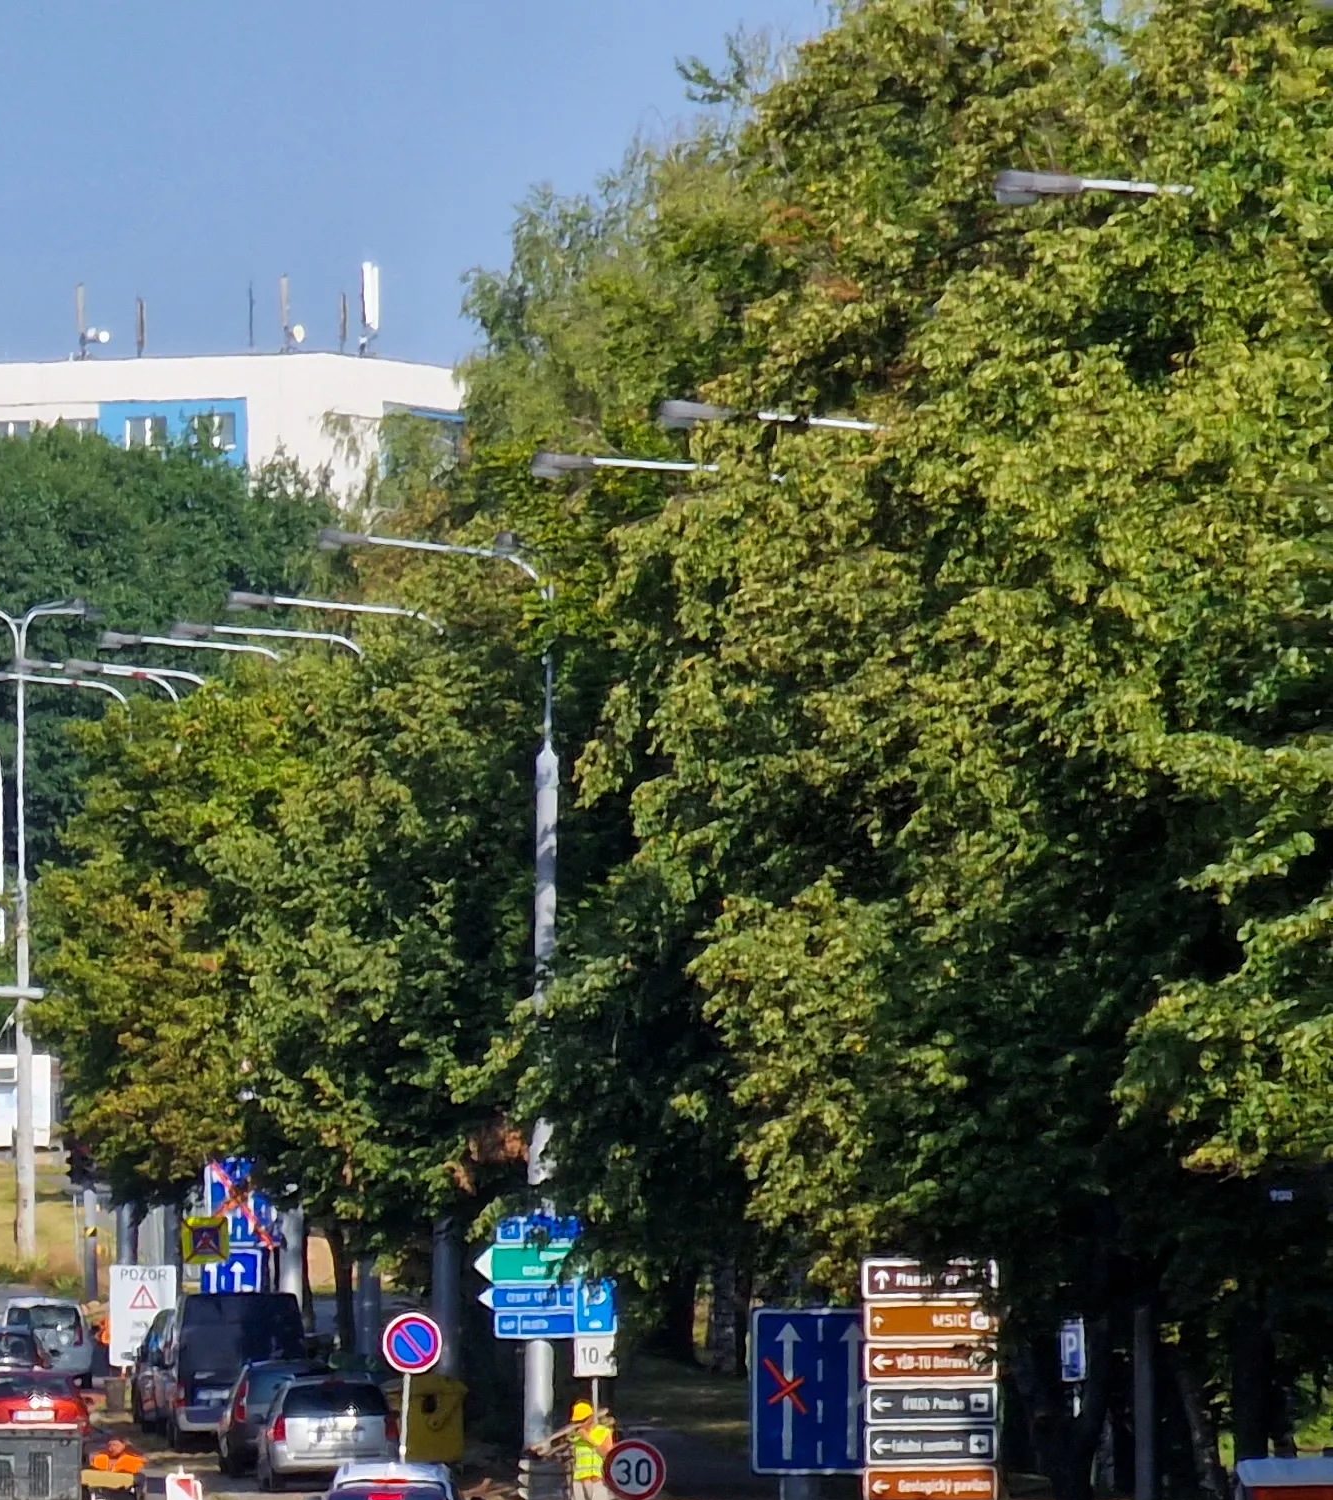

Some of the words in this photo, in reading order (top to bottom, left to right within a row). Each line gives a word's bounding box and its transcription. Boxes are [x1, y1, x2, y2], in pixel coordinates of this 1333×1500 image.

[120, 1268, 167, 1281] POZOR
[932, 1313, 967, 1328] MSIC
[583, 1347, 599, 1365] 10
[1065, 1332, 1077, 1366] P
[615, 1457, 652, 1487] 30
